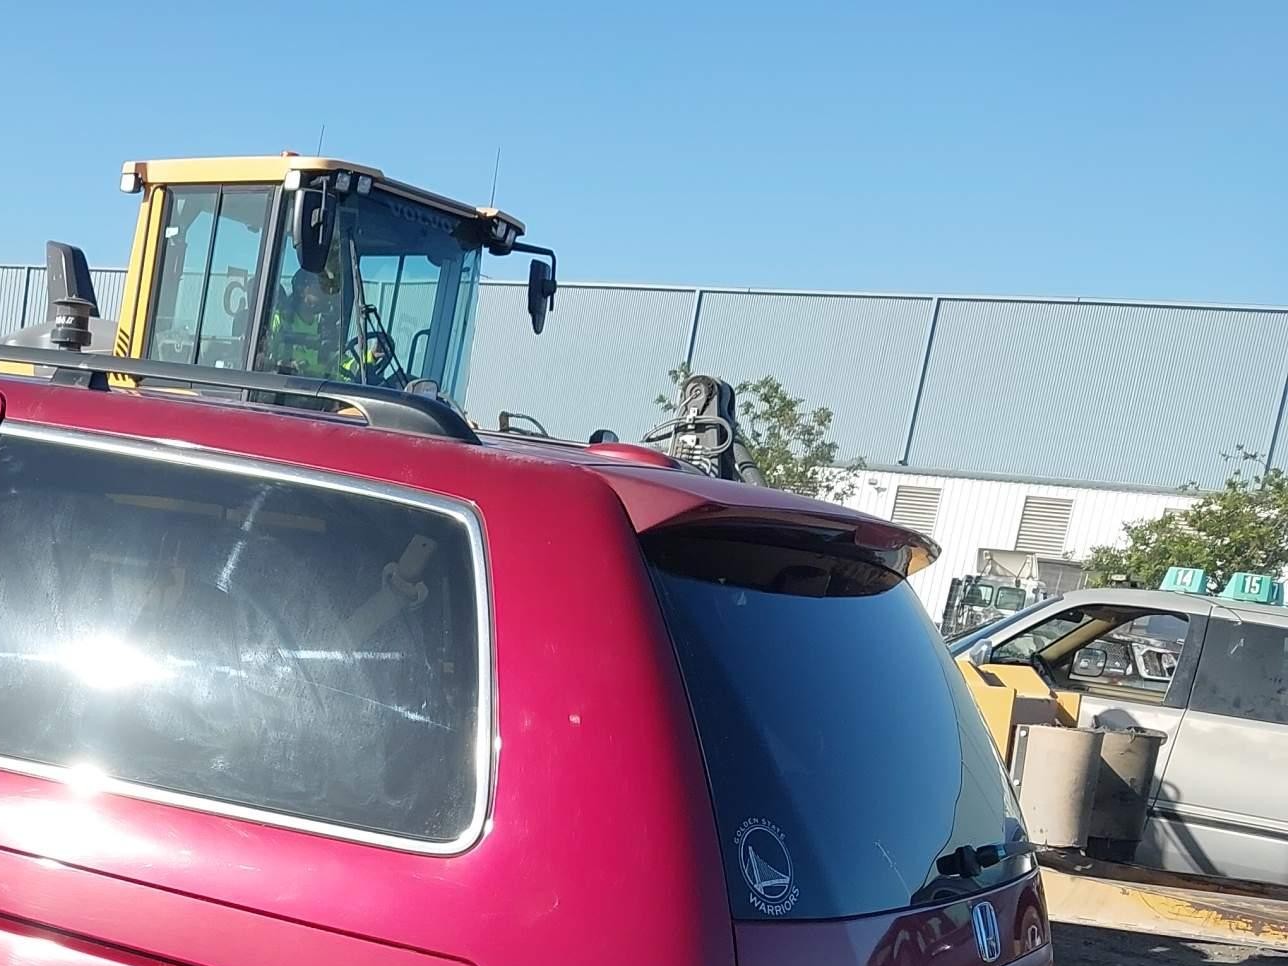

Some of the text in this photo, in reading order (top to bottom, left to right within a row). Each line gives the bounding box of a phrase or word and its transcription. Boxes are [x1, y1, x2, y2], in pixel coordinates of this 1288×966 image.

[1176, 569, 1194, 587] 14
[1244, 575, 1261, 594] 15
[734, 817, 759, 845] GOLDEN
[749, 885, 801, 916] WARRIORS
